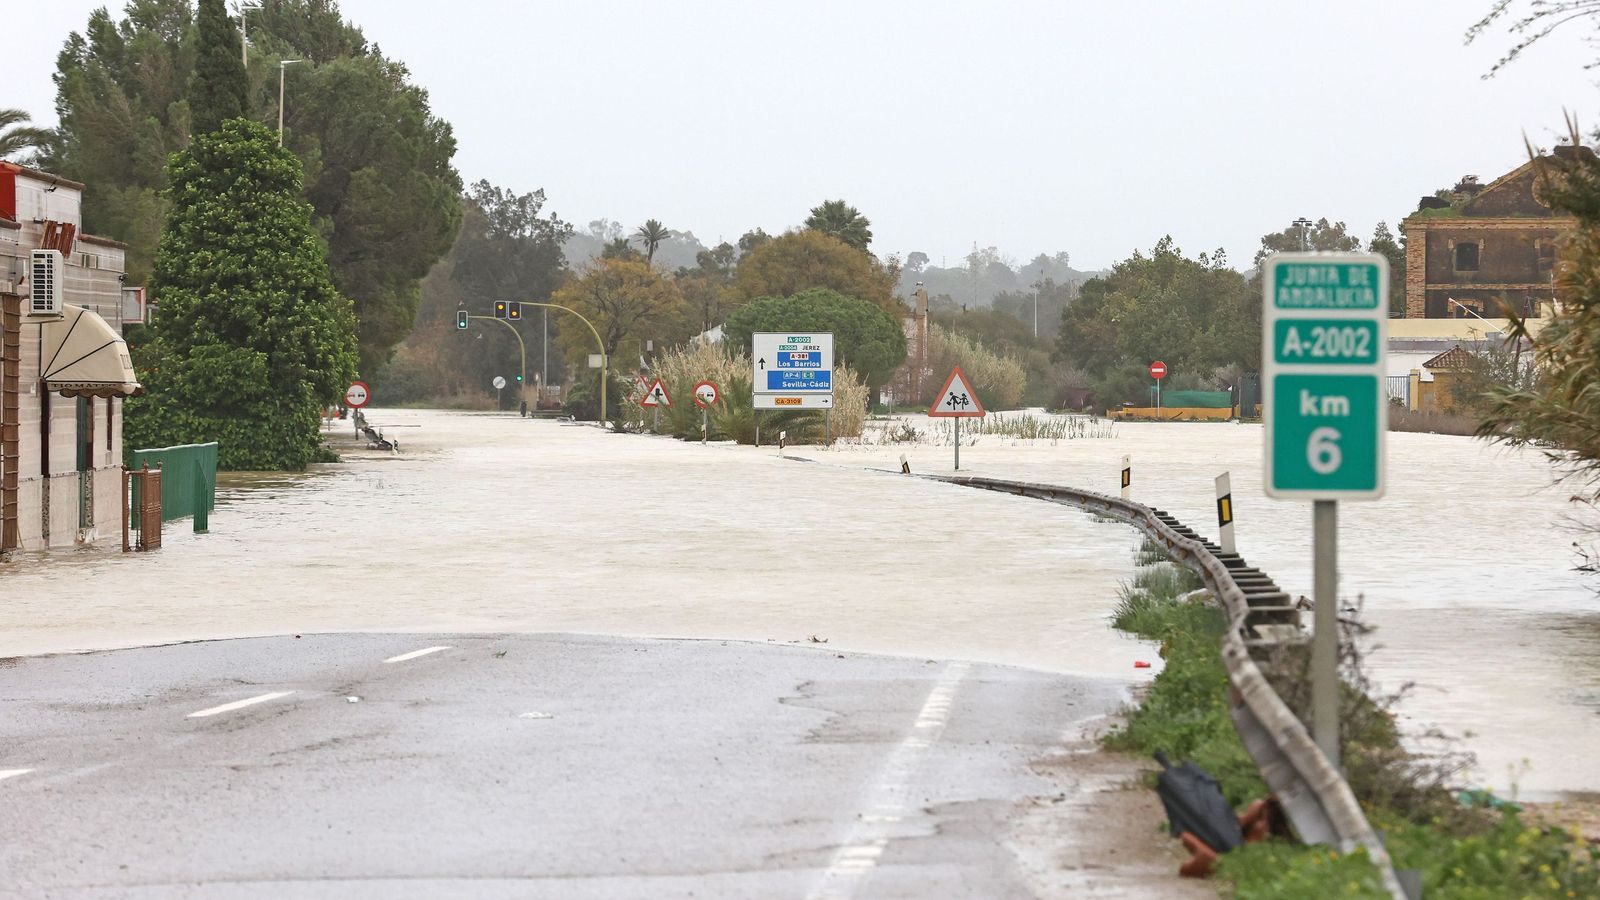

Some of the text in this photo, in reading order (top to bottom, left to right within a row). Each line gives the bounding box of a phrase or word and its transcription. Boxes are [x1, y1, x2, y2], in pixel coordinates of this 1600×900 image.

[1284, 266, 1370, 286] JUNTA DE
[1282, 326, 1370, 357] A-2002
[1300, 389, 1350, 416] km
[1306, 427, 1343, 475] 6
